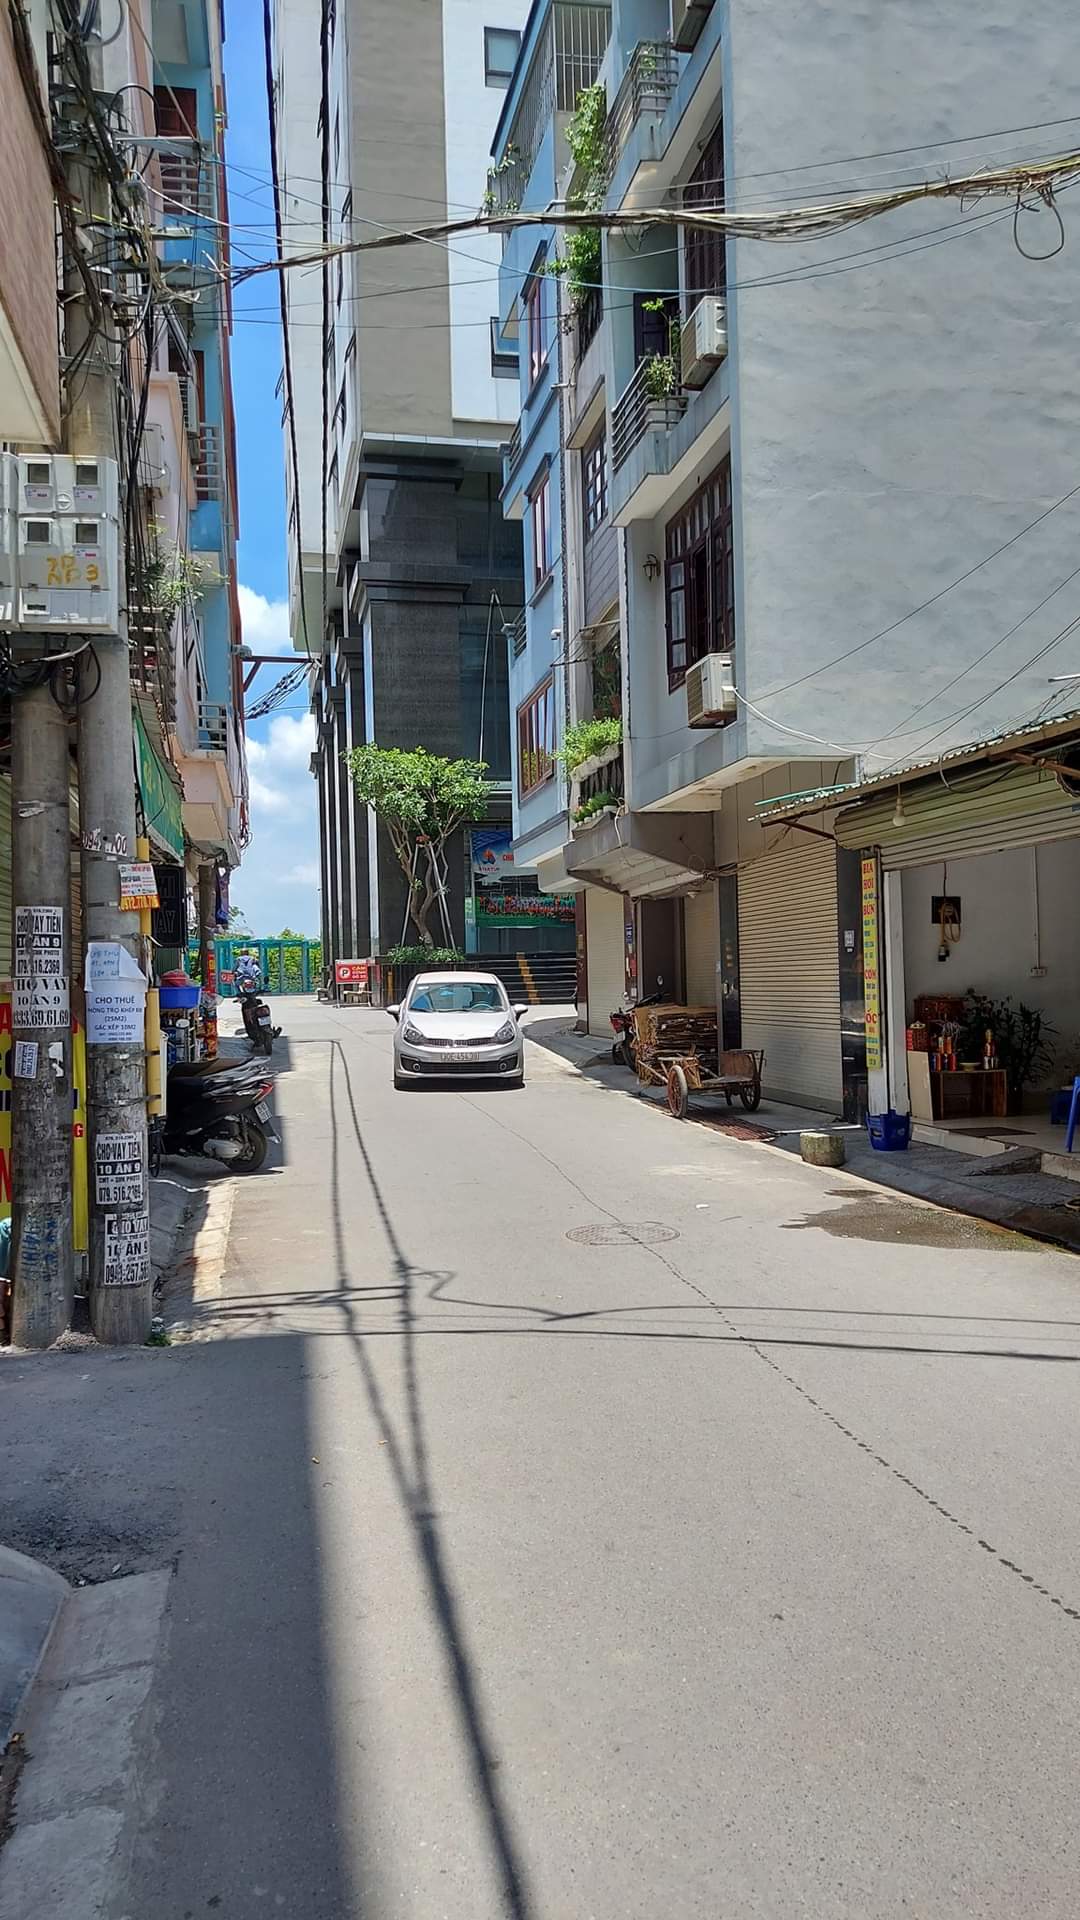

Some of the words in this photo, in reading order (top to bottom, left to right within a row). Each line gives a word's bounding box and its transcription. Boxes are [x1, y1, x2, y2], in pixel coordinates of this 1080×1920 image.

[53, 937, 60, 948] 9
[42, 978, 68, 991] VAY
[53, 995, 60, 1006] 9
[95, 996, 112, 1005] CHO
[866, 1007, 878, 1024] ỐC
[99, 1165, 112, 1175] 10
[134, 1162, 141, 1172] 9
